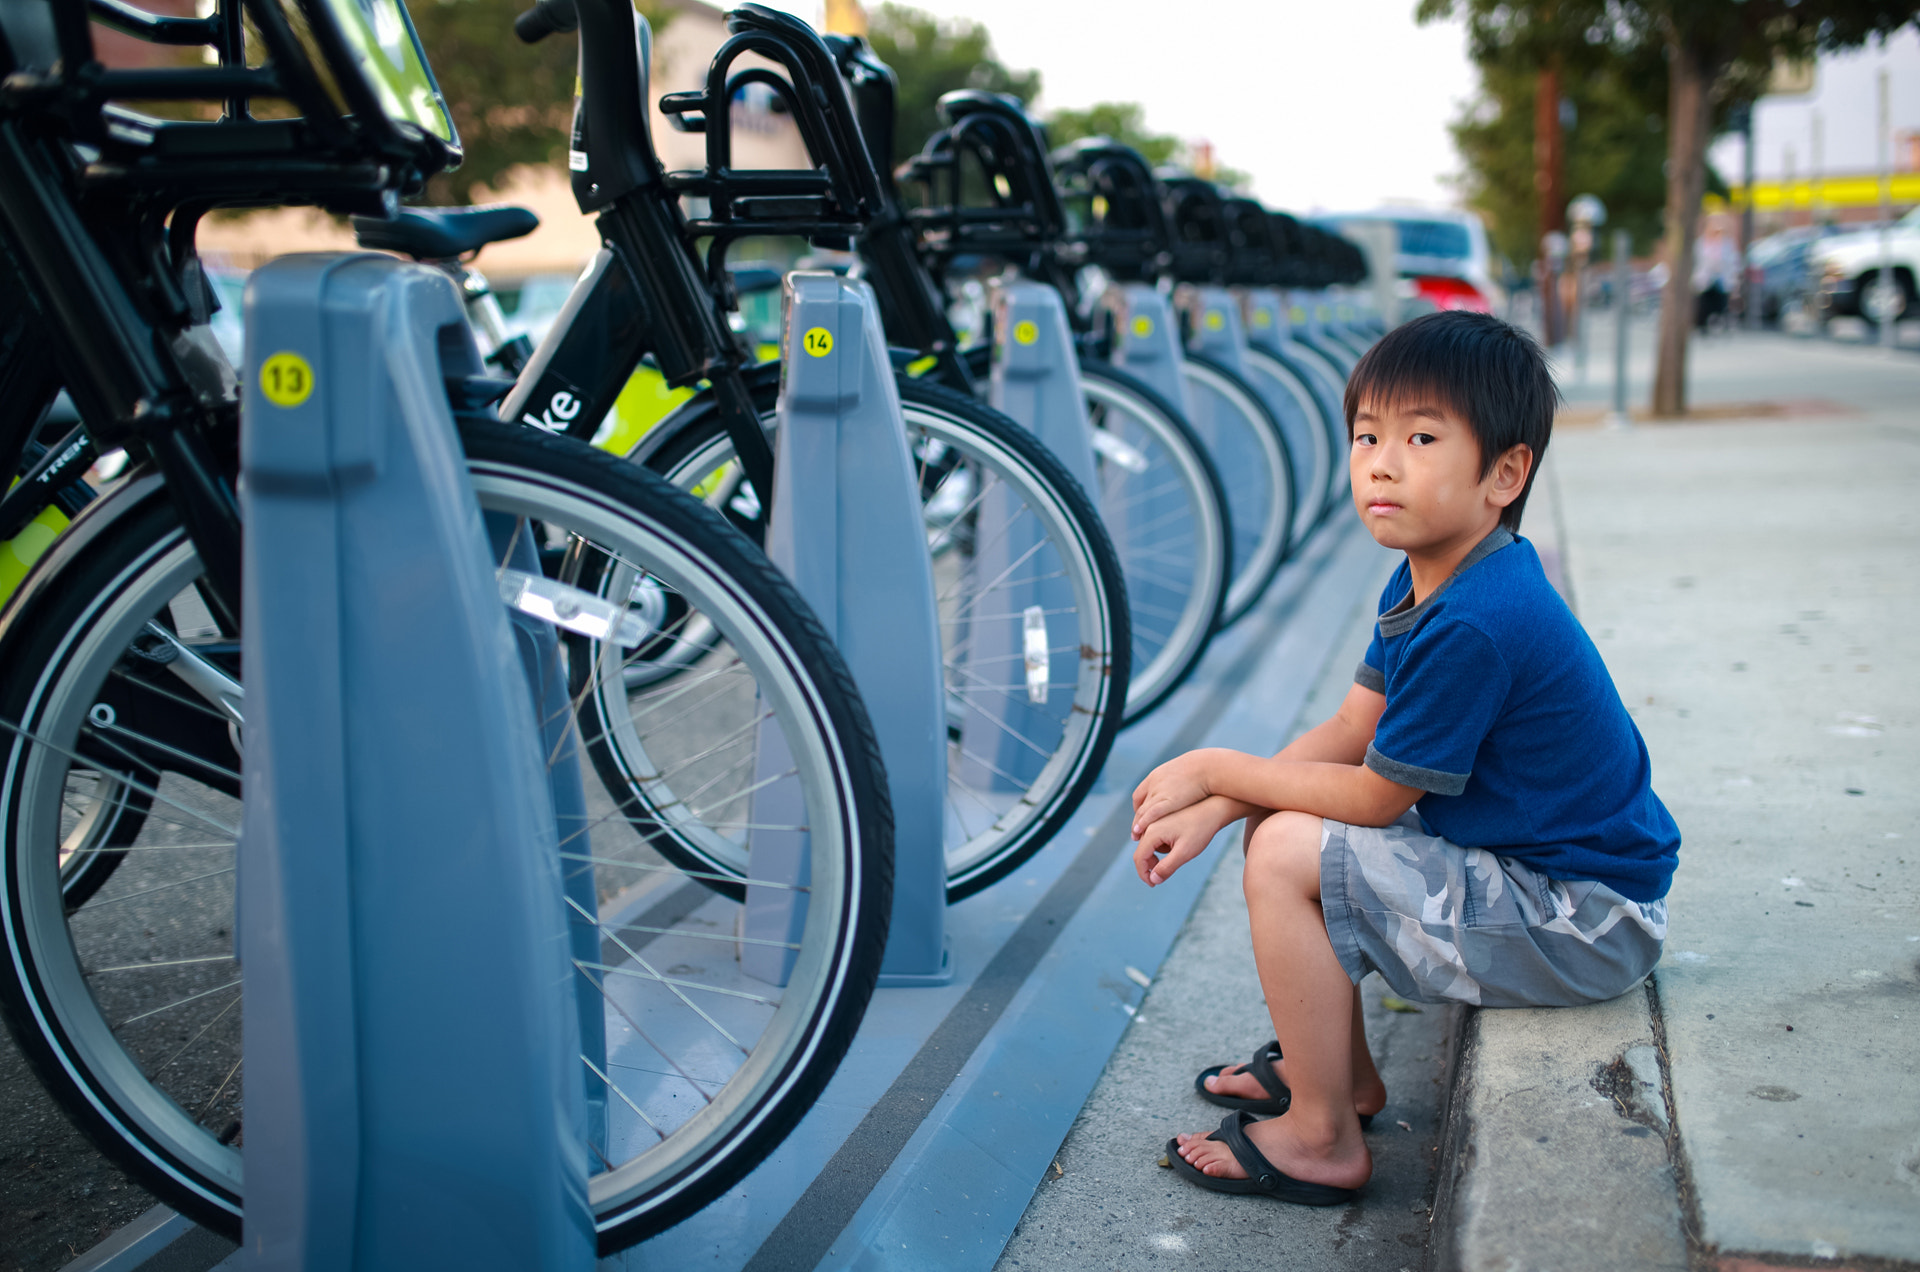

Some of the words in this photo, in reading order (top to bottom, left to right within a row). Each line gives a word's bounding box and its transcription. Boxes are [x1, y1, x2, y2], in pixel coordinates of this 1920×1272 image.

[807, 333, 827, 349] 14
[268, 365, 304, 394] 13
[521, 391, 581, 436] ke
[36, 433, 89, 483] TREK
